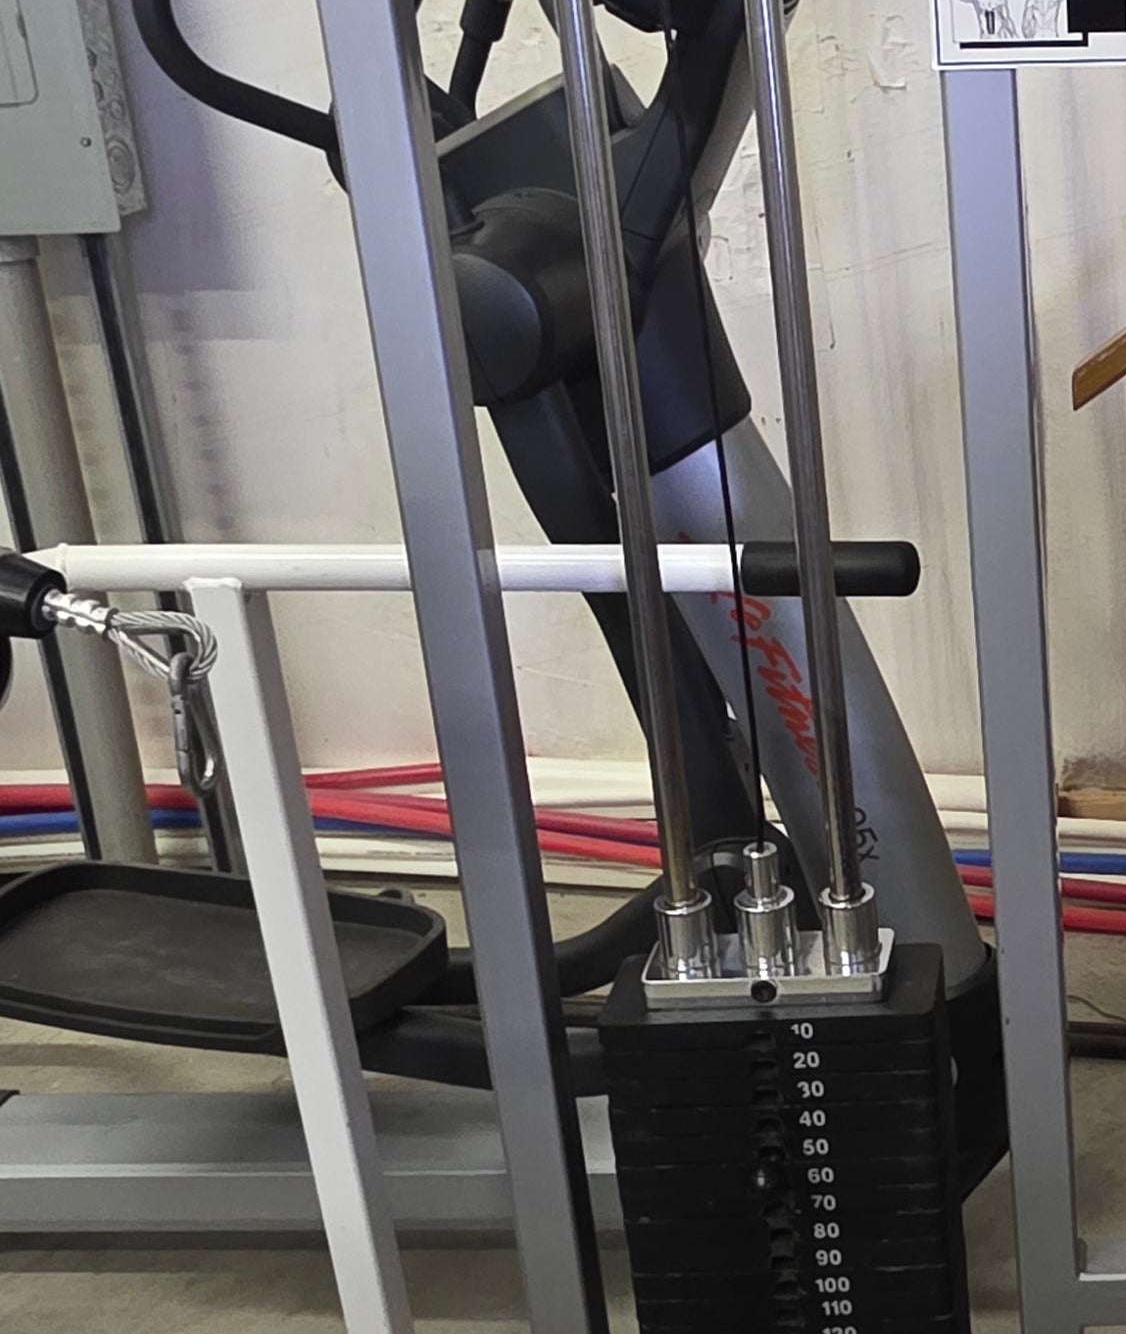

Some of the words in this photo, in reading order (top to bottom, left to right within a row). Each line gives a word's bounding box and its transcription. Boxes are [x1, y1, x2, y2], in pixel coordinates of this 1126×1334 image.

[790, 1022, 814, 1039] 10
[793, 1051, 820, 1069] 20
[797, 1080, 825, 1098] 30
[799, 1109, 826, 1127] 40
[803, 1138, 829, 1156] 50
[807, 1167, 834, 1184] 60
[812, 1194, 836, 1211] 70
[813, 1222, 840, 1239] 80
[815, 1249, 842, 1266] 90
[815, 1276, 850, 1293] 100
[822, 1299, 853, 1316] 110
